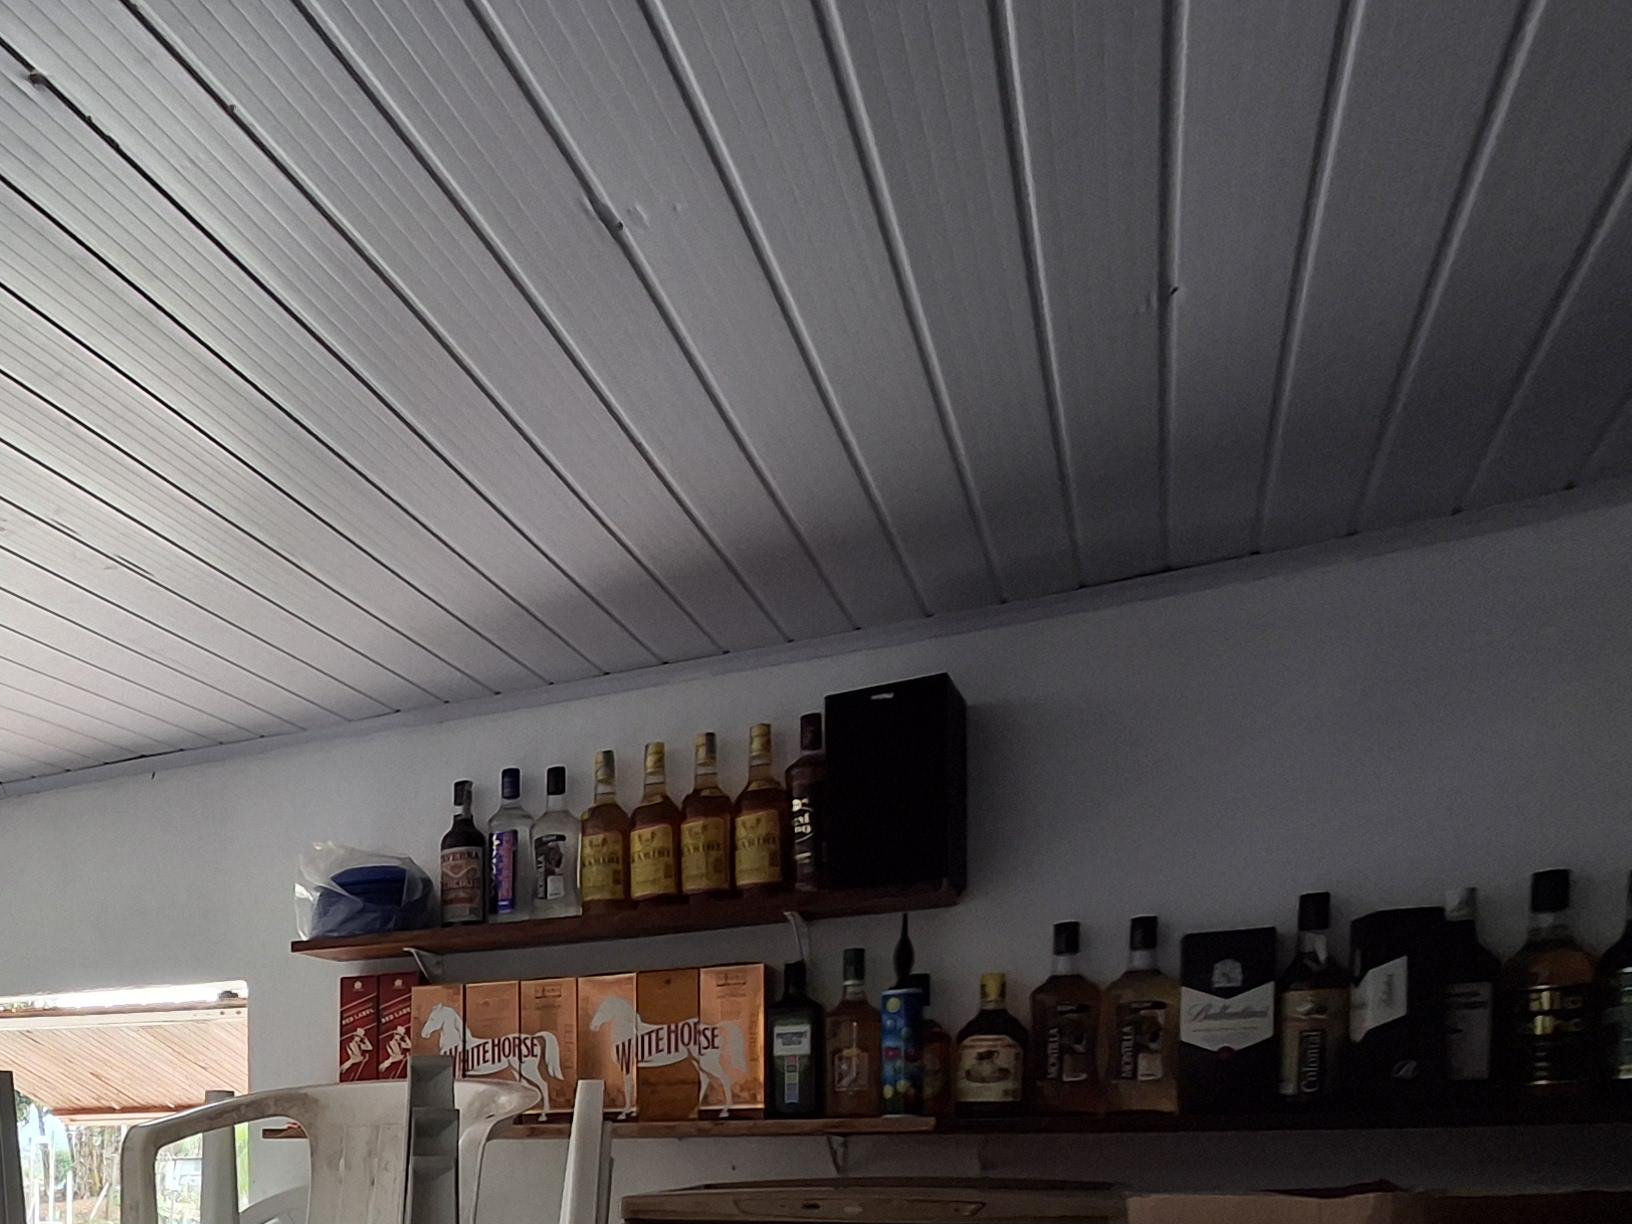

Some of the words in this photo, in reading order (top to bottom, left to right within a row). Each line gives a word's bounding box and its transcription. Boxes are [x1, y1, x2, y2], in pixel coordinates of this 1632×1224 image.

[491, 1035, 539, 1065] HORSE
[615, 1027, 665, 1075] WITE
[666, 1021, 720, 1056] HORSE
[1047, 1027, 1061, 1079] MONTILLA
[1121, 1025, 1134, 1077] MONTILLA
[1299, 1031, 1322, 1094] Colonial
